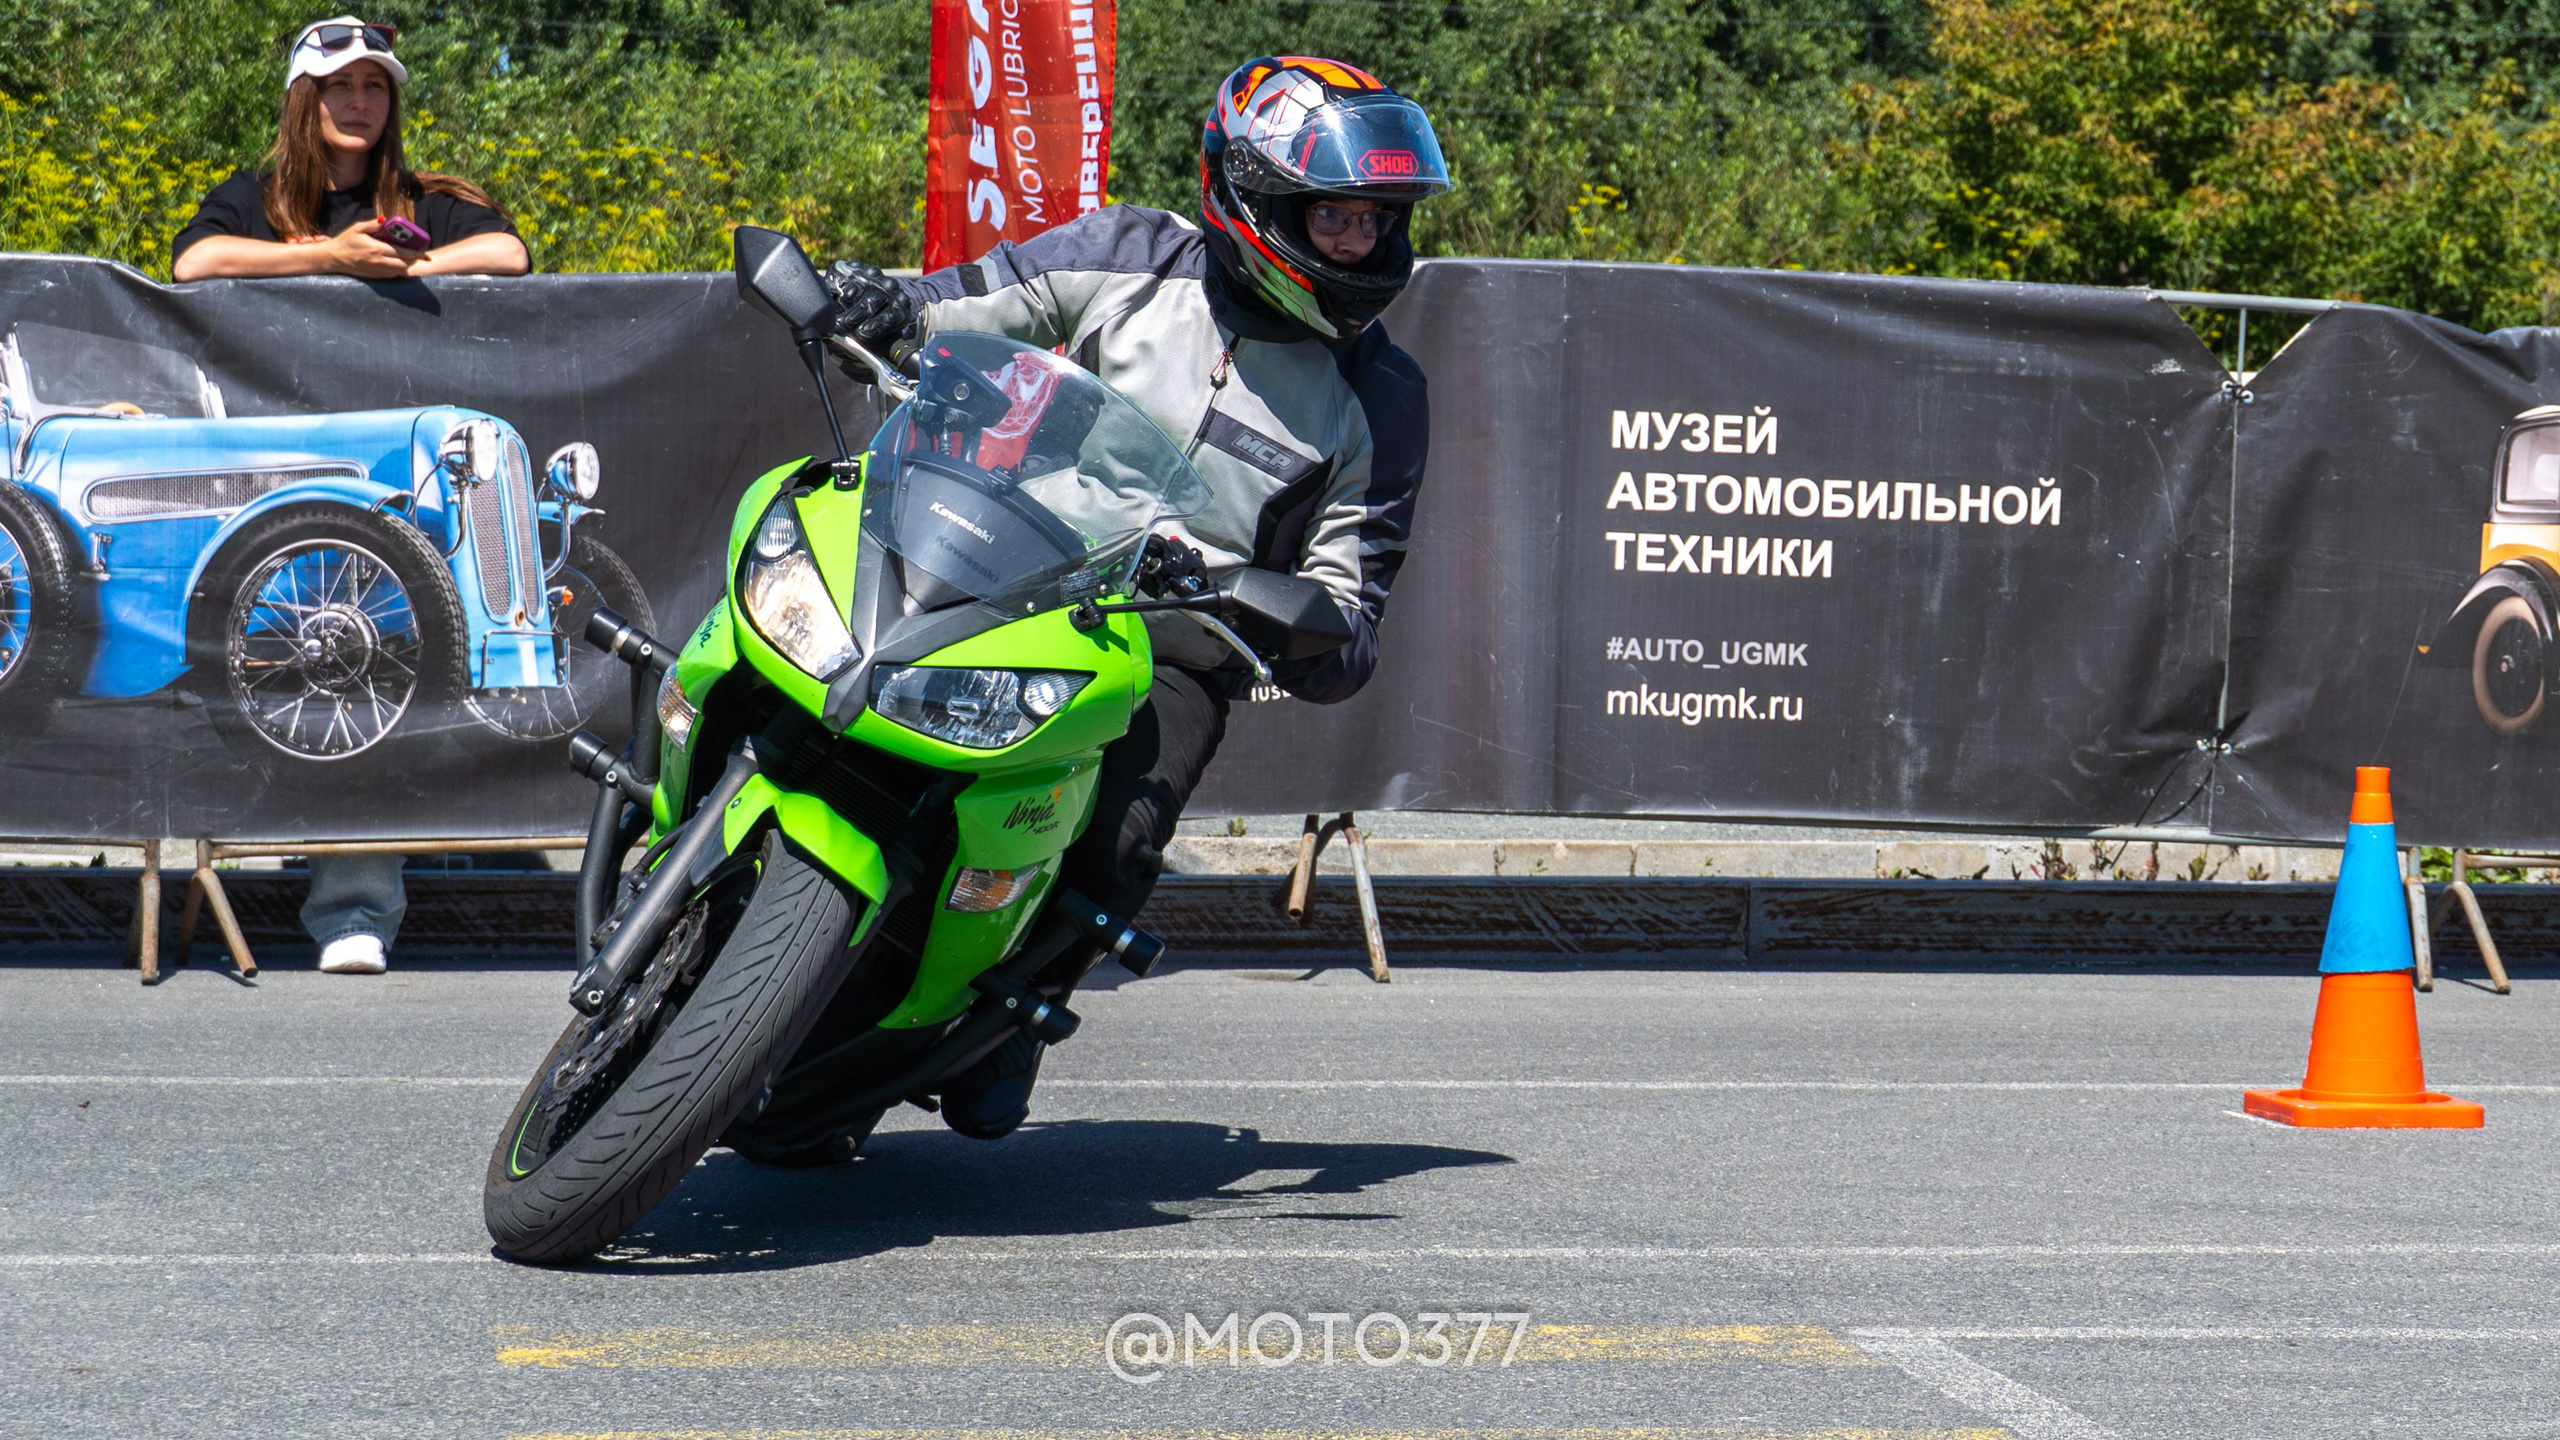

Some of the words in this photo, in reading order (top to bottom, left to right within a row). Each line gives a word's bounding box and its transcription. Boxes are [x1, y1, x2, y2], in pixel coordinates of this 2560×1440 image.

[1013, 125, 1047, 223] MOTO
[1369, 155, 1413, 174] SHOEI
[1233, 431, 1293, 468] MCP
[1611, 406, 1778, 455] МУЗЕЙ
[1606, 472, 2062, 526] АВТОМОБИЛЬНОЙ
[929, 502, 995, 544] Kawasaki
[1606, 531, 1834, 578] ТЕХНИКИ
[1606, 637, 1808, 669] #AUTO_UGMK
[1606, 685, 1803, 726] mkugmk.ru
[1002, 794, 1055, 835] Ninja
